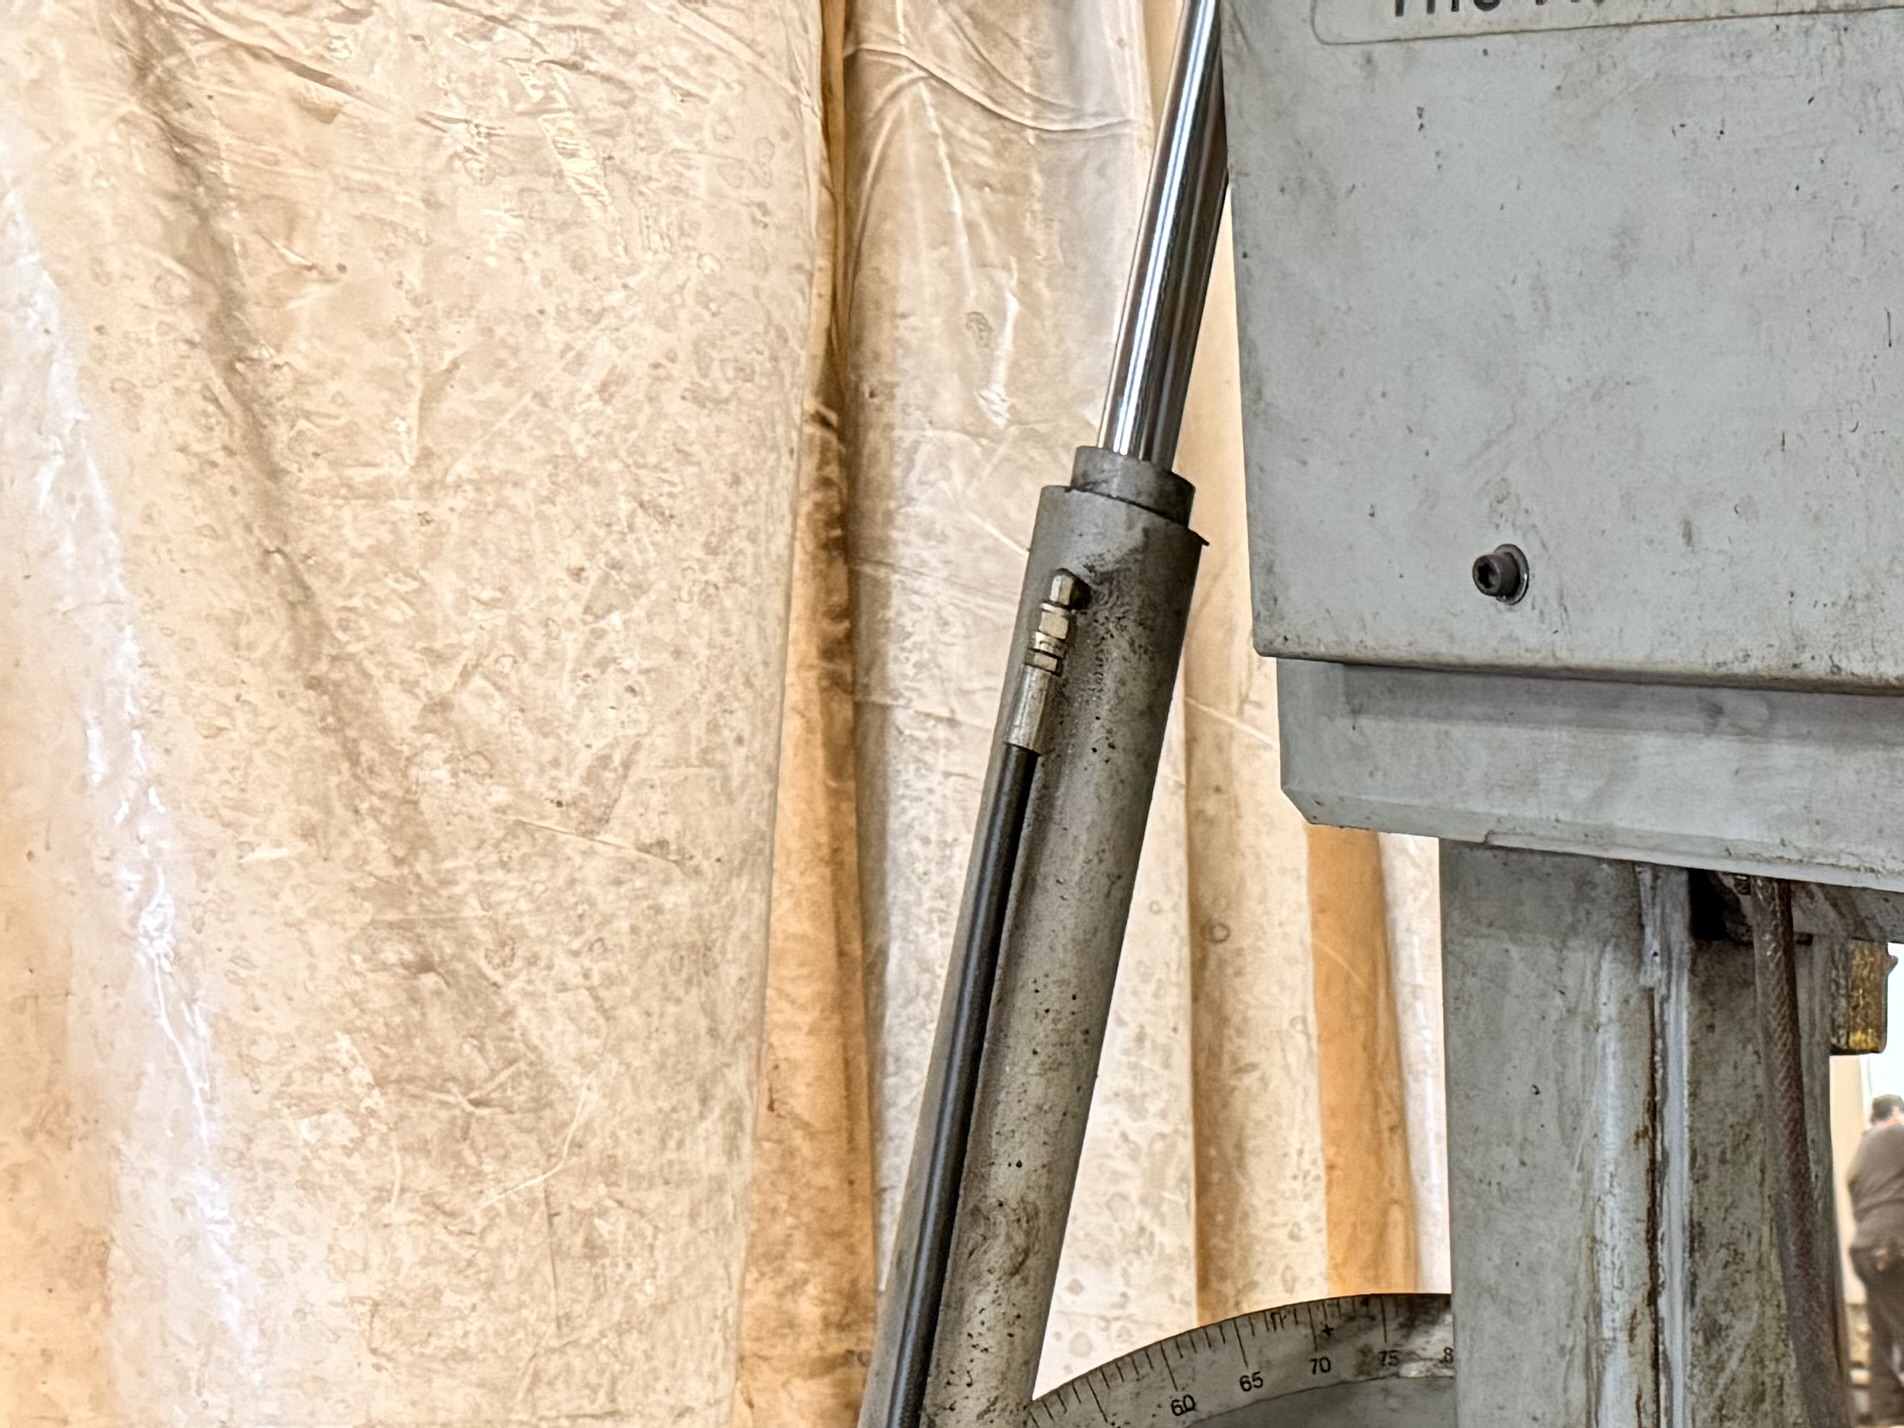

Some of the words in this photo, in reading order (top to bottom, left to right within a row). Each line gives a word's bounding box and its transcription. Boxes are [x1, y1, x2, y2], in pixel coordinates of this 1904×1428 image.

[1170, 1394, 1197, 1418] 60
[1238, 1370, 1264, 1393] 65
[1309, 1355, 1332, 1375] 70
[1378, 1349, 1400, 1368] 75
